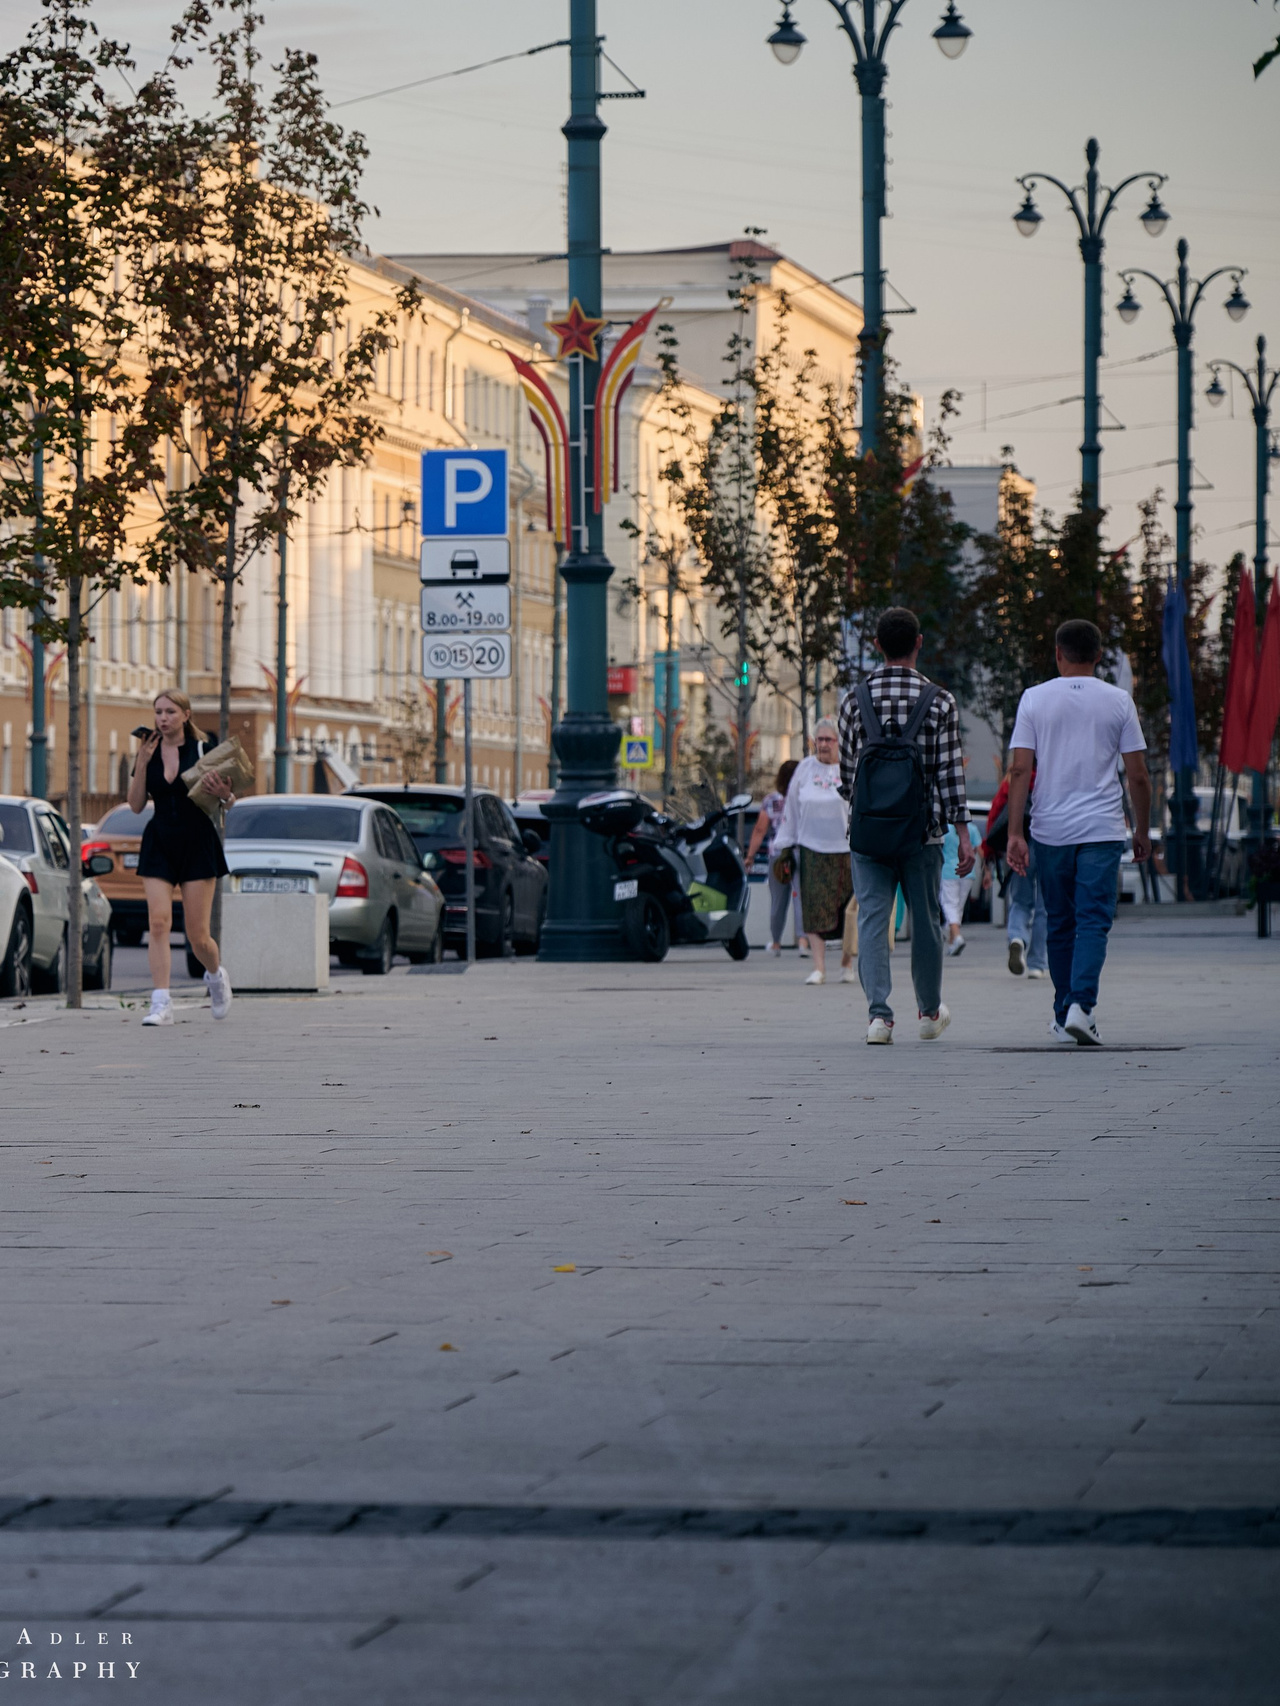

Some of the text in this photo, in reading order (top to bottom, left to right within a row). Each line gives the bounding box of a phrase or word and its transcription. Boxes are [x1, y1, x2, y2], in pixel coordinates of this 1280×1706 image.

[445, 458, 493, 528] P
[427, 611, 505, 626] 8.00-19.00
[434, 646, 500, 665] 10 15 20
